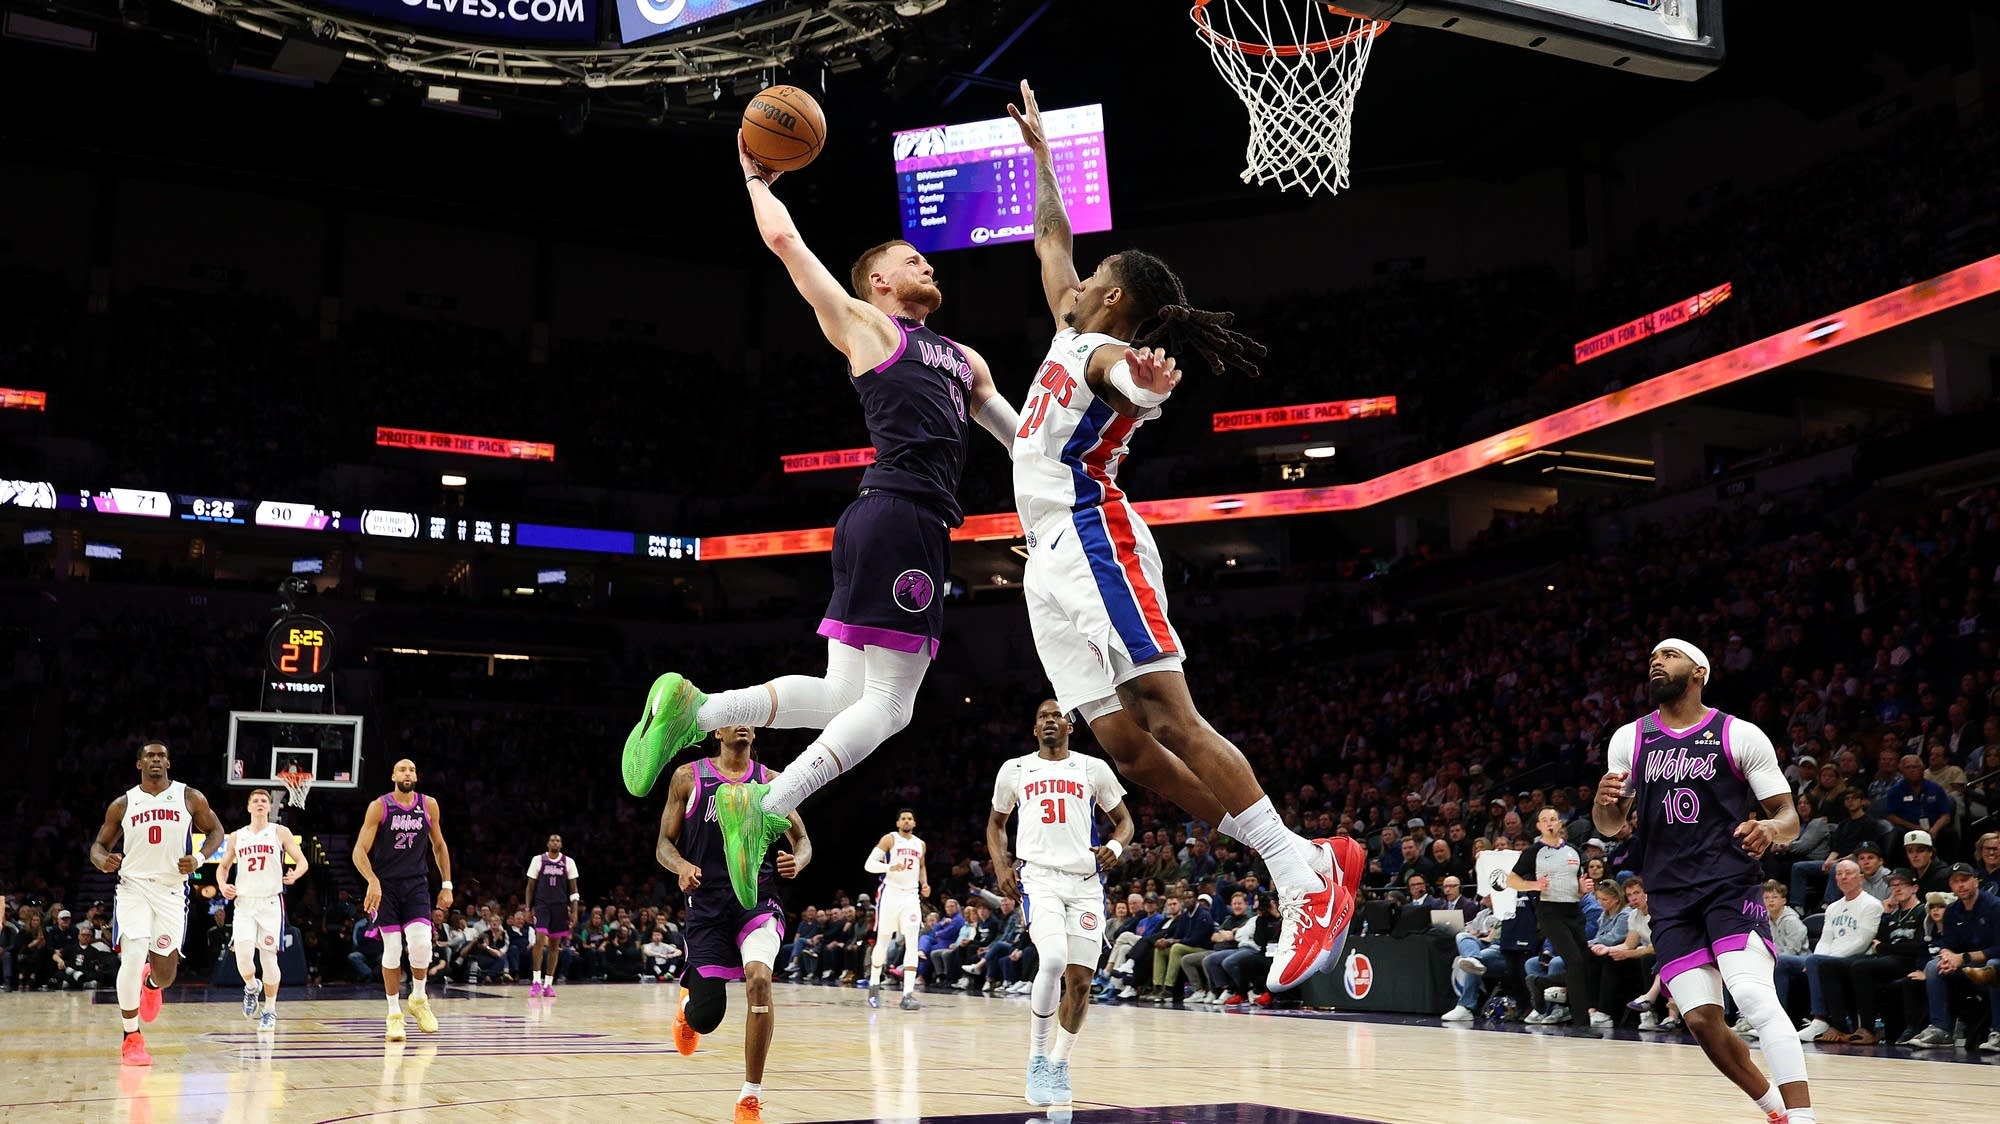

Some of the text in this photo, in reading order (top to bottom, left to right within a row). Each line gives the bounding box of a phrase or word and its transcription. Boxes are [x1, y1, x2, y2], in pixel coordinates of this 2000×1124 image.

[752, 99, 797, 131] Wilson
[919, 205, 938, 215] Reid
[990, 224, 1035, 239] LEXU
[1576, 333, 1615, 359] PROTEIN
[1618, 326, 1637, 343] FOR
[1659, 306, 1685, 327] PACK
[918, 340, 974, 390] Wolves
[1017, 392, 1052, 439] 24
[1215, 405, 1345, 428] PROTEIN FOR THE PACK
[378, 430, 506, 454] PROTEIN FOR THE PACK
[786, 456, 820, 469] ROTEIN
[80, 498, 88, 508] 3
[137, 495, 156, 509] 71
[193, 499, 235, 518] 6:25
[272, 507, 290, 521] 90
[332, 519, 340, 529] 4
[372, 524, 408, 535] PISTONS
[649, 535, 667, 547] PHI
[648, 546, 667, 557] CHA
[686, 544, 694, 555] 3
[290, 629, 324, 646] 6:25
[281, 644, 320, 673] 21
[286, 683, 325, 692] TISSOT
[1645, 747, 1718, 783] Wolves
[1024, 779, 1084, 800] PISTONS
[1040, 798, 1066, 823] 31
[1662, 787, 1699, 824] 10
[131, 809, 181, 827] PISTONS
[391, 815, 423, 831] Wolves
[149, 826, 161, 844] 0
[394, 832, 418, 849] 27
[238, 845, 274, 858] PISTONS
[248, 856, 266, 872] 27
[904, 858, 914, 870] 12
[549, 876, 557, 887] 11
